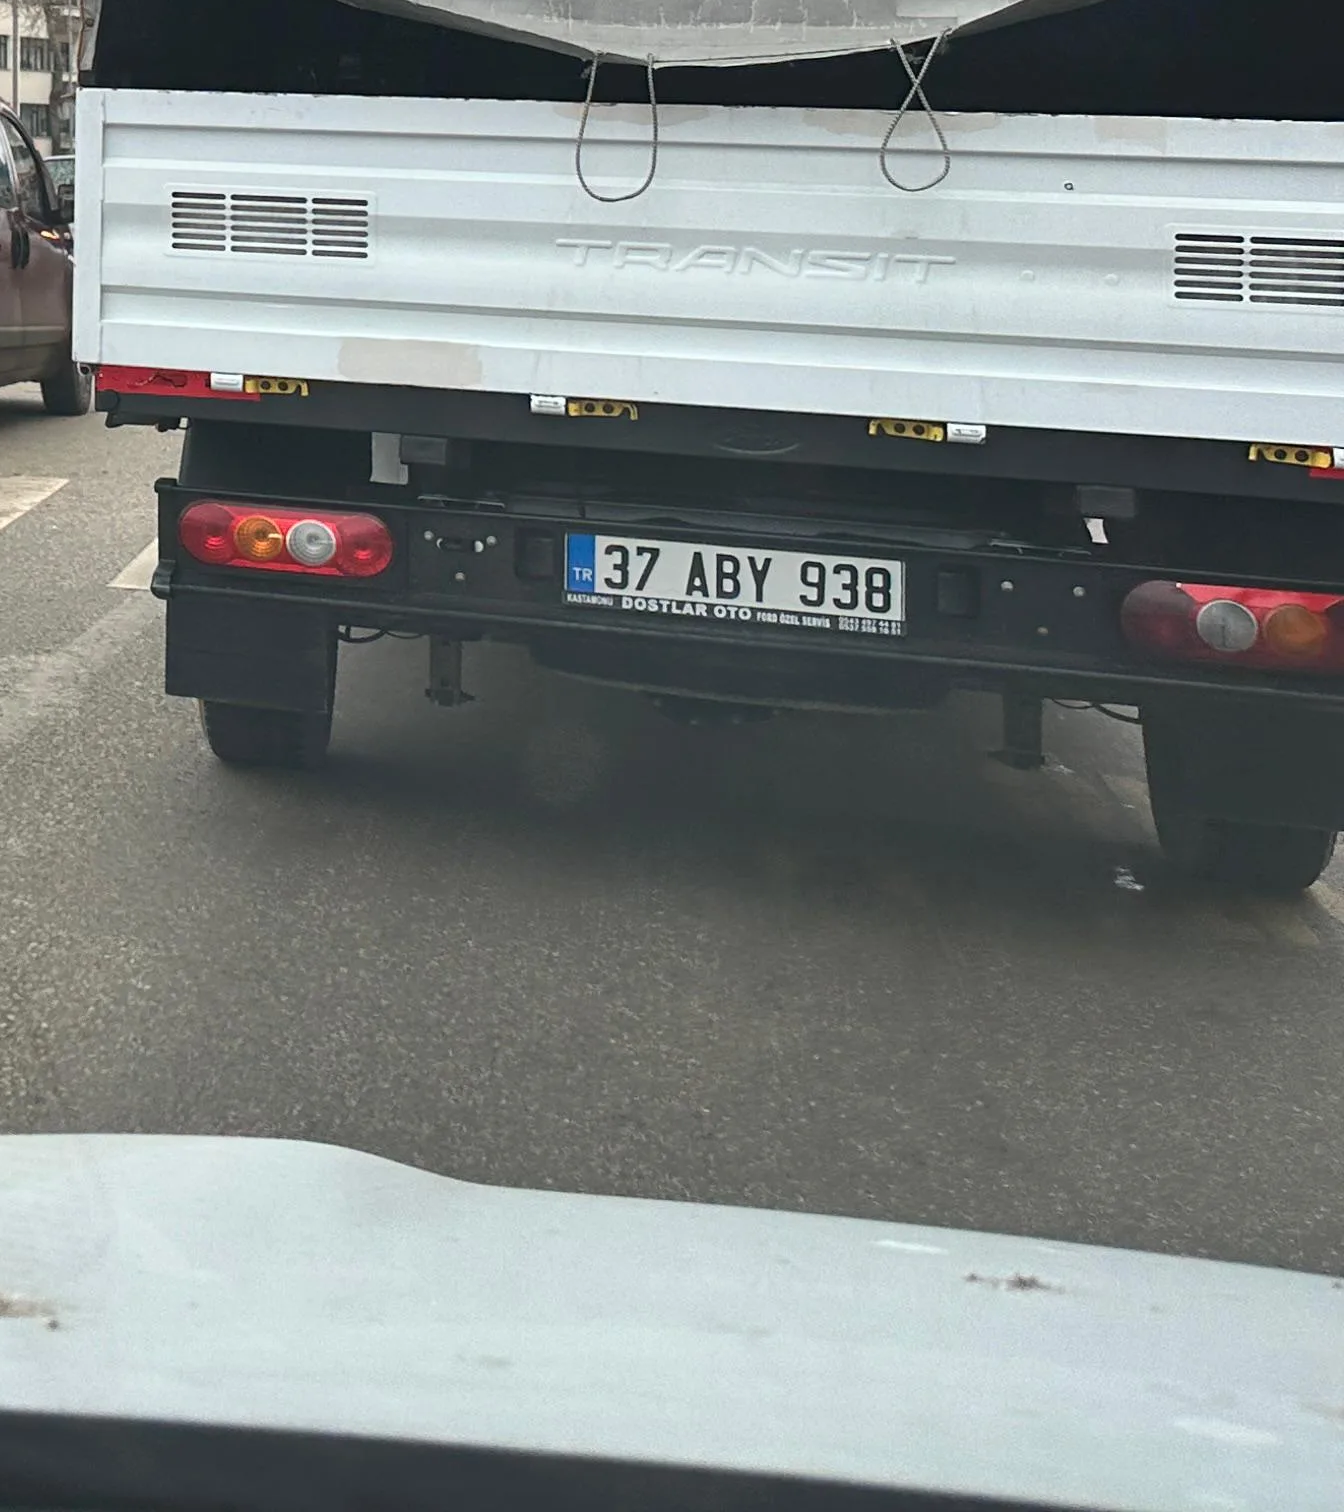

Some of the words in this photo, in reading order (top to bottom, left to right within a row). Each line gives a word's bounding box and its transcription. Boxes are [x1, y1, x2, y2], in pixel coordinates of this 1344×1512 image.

[555, 238, 957, 283] TRANSIT
[572, 566, 593, 583] TR
[603, 544, 661, 591] 37
[685, 551, 773, 603] ABY
[799, 560, 892, 614] 938
[621, 596, 708, 617] DOSTLAR
[713, 605, 752, 621] OTO
[756, 611, 778, 623] FORD
